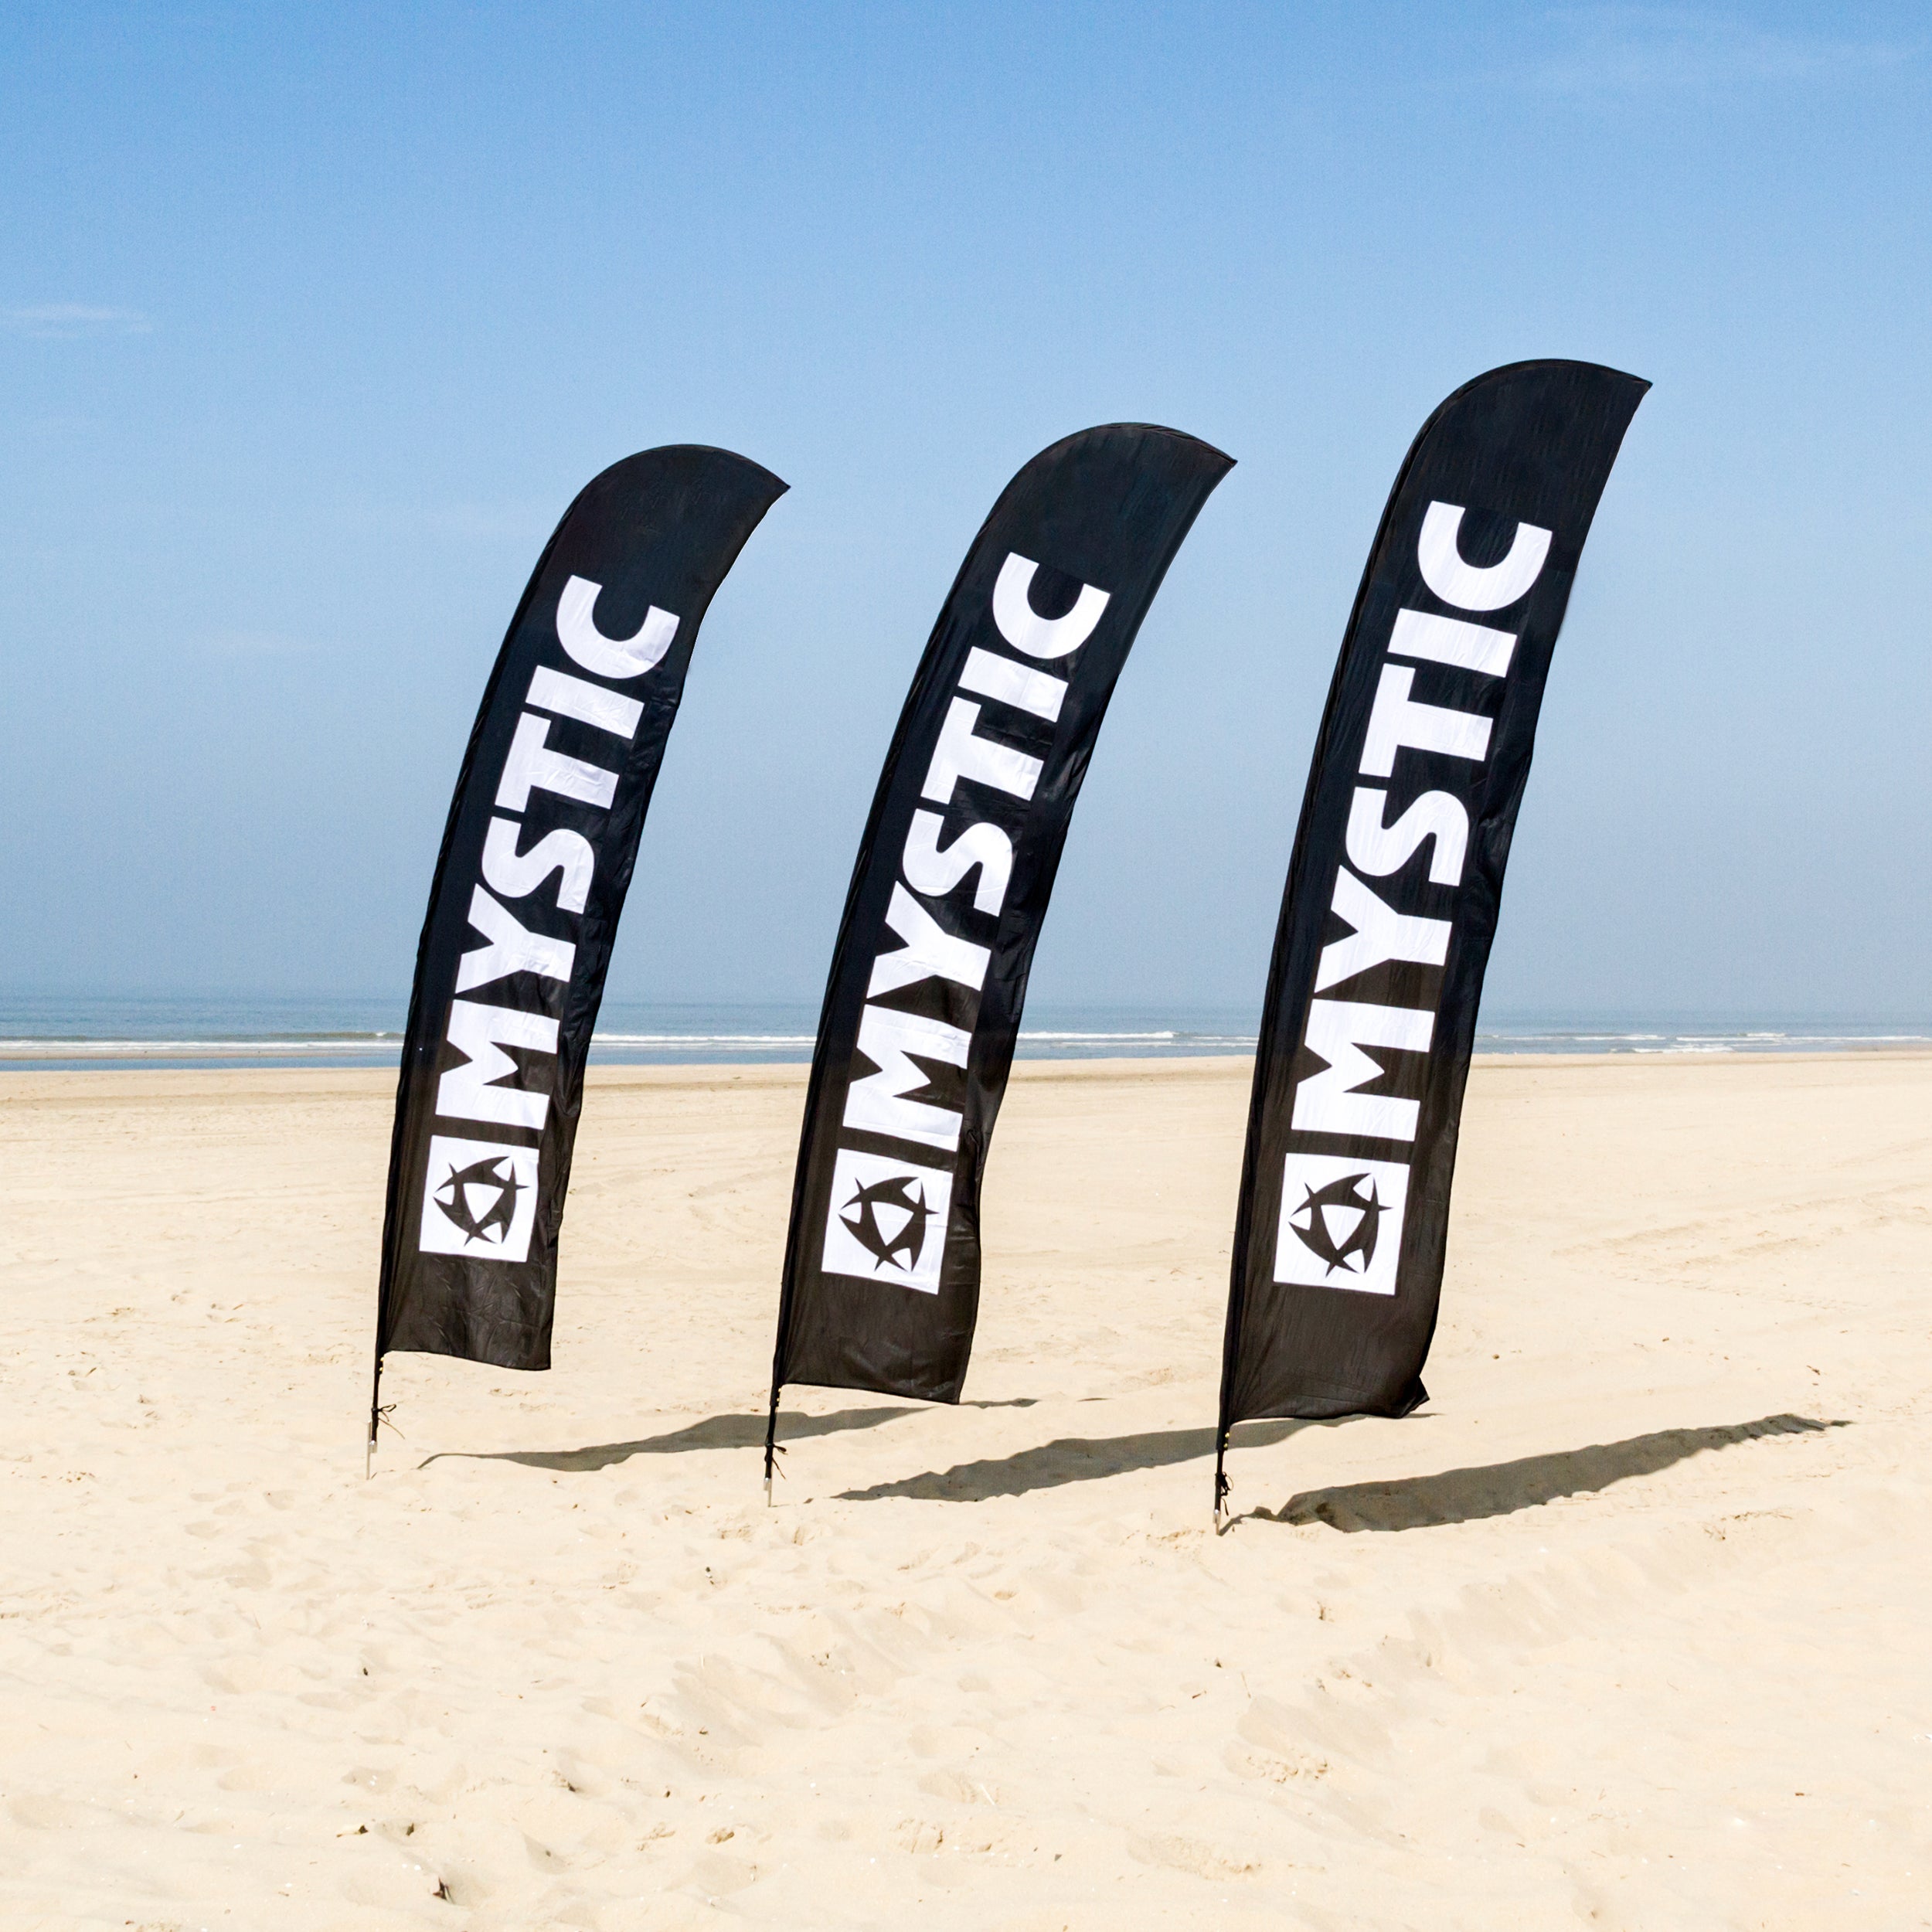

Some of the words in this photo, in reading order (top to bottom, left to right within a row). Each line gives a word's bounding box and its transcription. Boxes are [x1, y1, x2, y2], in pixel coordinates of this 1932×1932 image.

[435, 574, 680, 1131] MYSTIC
[842, 552, 1111, 1152] MYSTIC
[1291, 500, 1553, 1142] MYSTIC
